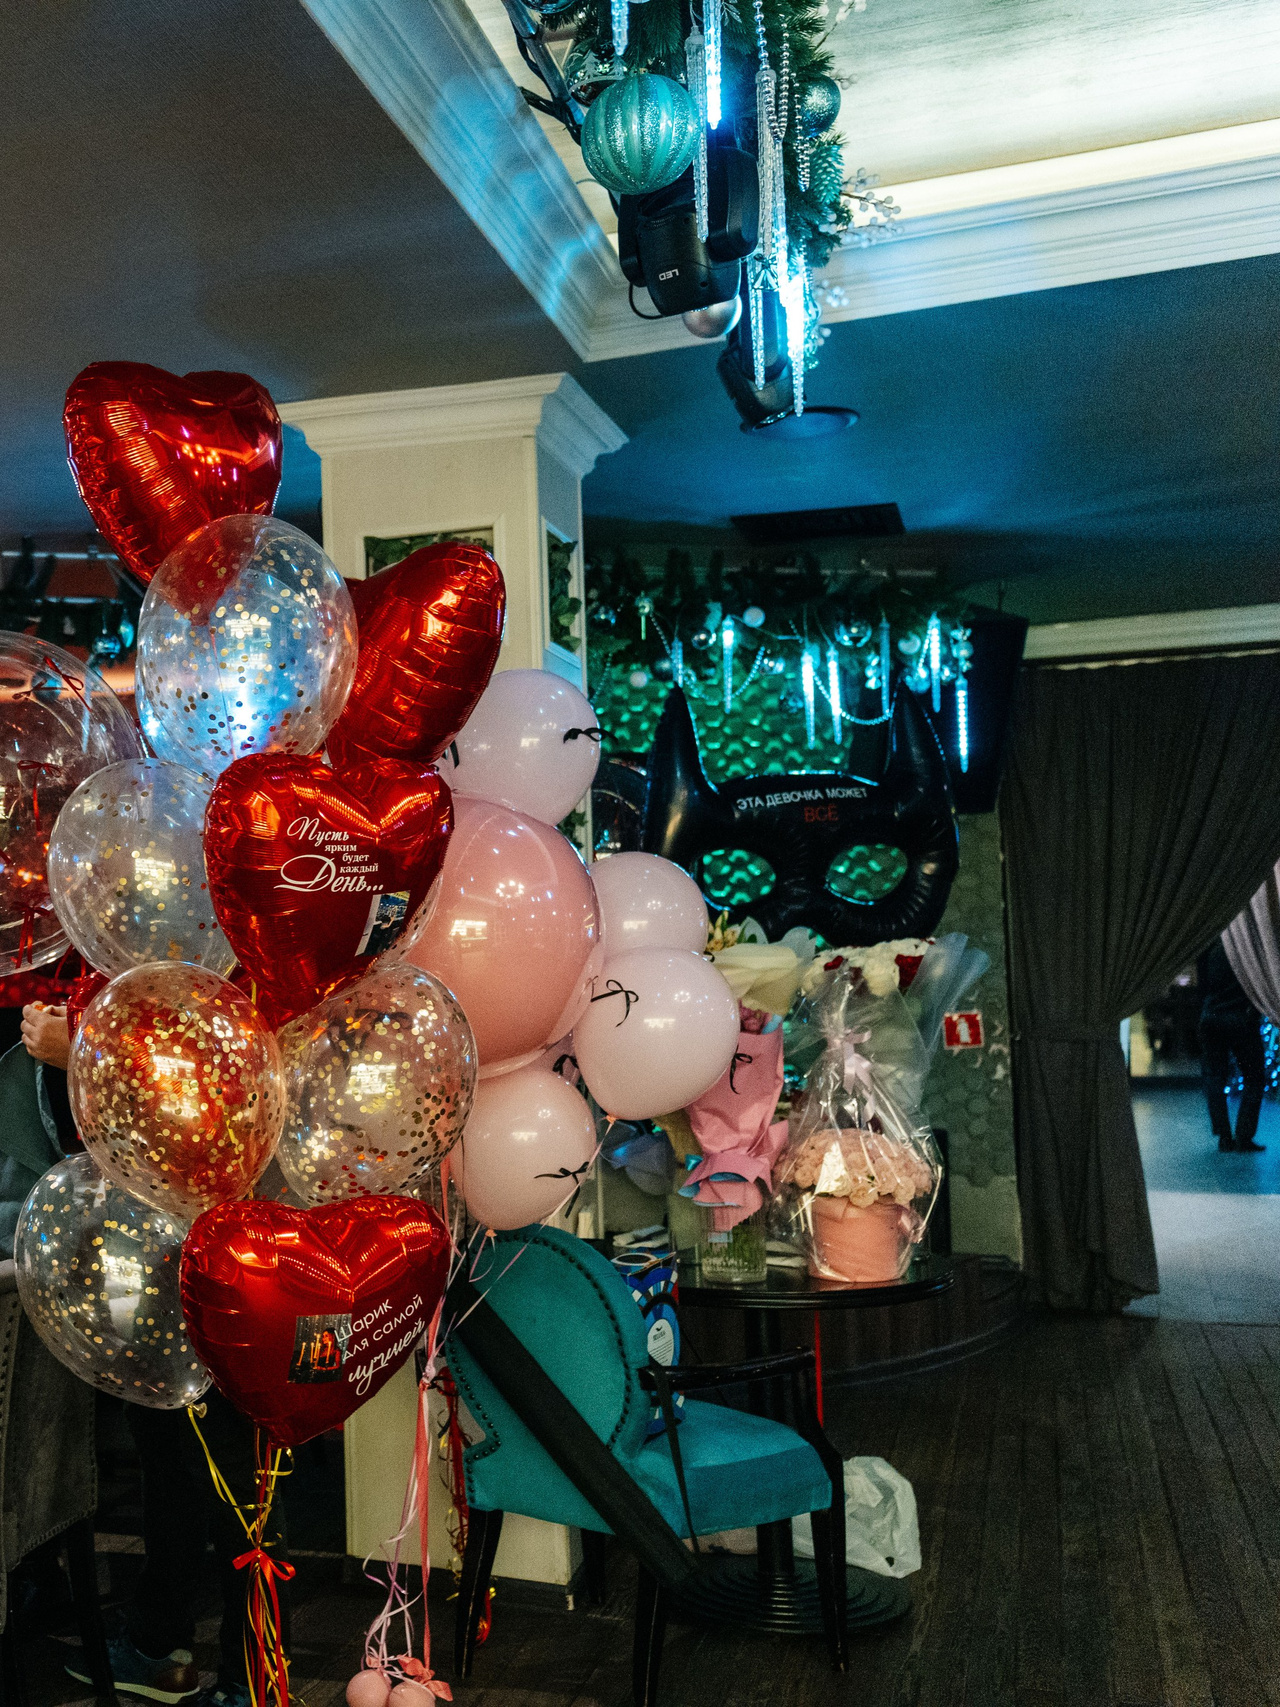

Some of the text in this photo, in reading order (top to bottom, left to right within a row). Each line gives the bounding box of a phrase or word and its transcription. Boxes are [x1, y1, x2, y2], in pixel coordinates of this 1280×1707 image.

[659, 268, 679, 281] LED
[736, 787, 868, 811] ЭТА ДЕВОЧКА МОЖЕТ
[287, 816, 350, 847] Пусть
[324, 844, 357, 854] ярким
[342, 853, 369, 864] будет
[273, 854, 384, 892] День...
[339, 863, 379, 874] каждый
[334, 1299, 393, 1342] Шарик
[372, 1294, 423, 1341] самой
[348, 1317, 425, 1396] лучшей
